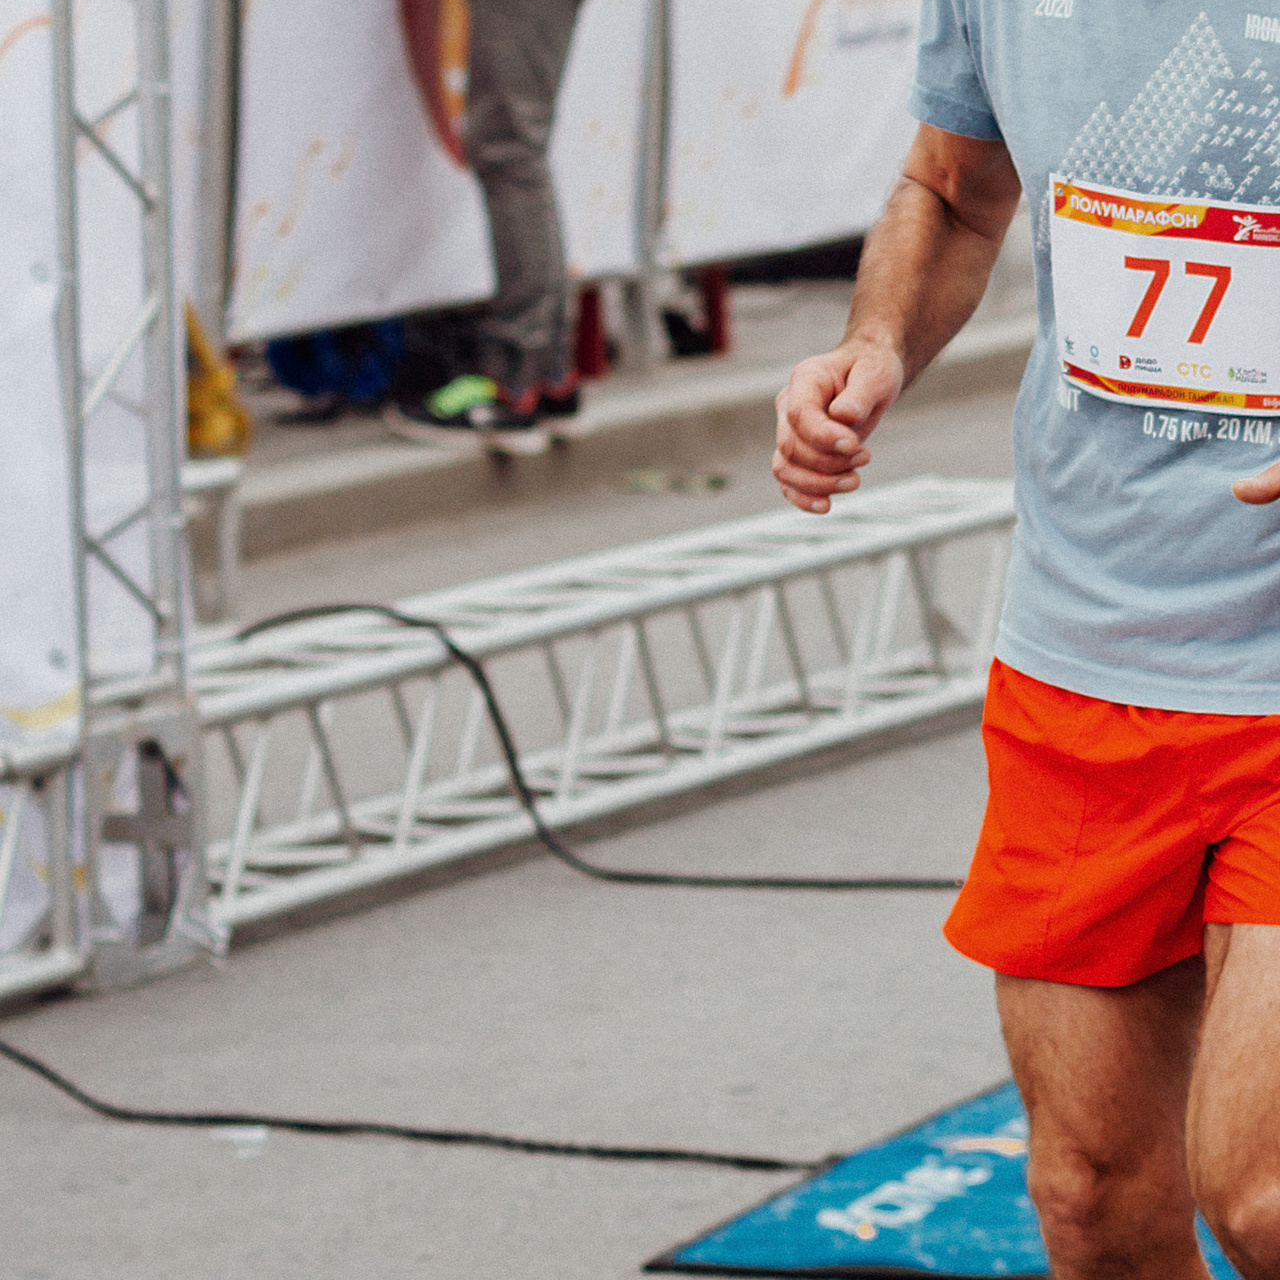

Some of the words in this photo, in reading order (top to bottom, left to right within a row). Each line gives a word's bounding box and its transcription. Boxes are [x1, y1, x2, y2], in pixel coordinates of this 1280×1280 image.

[1069, 194, 1198, 229] ПОЛУМАРАФОН
[1124, 255, 1232, 344] 77
[1142, 411, 1178, 441] 0,75
[1216, 418, 1241, 441] 20
